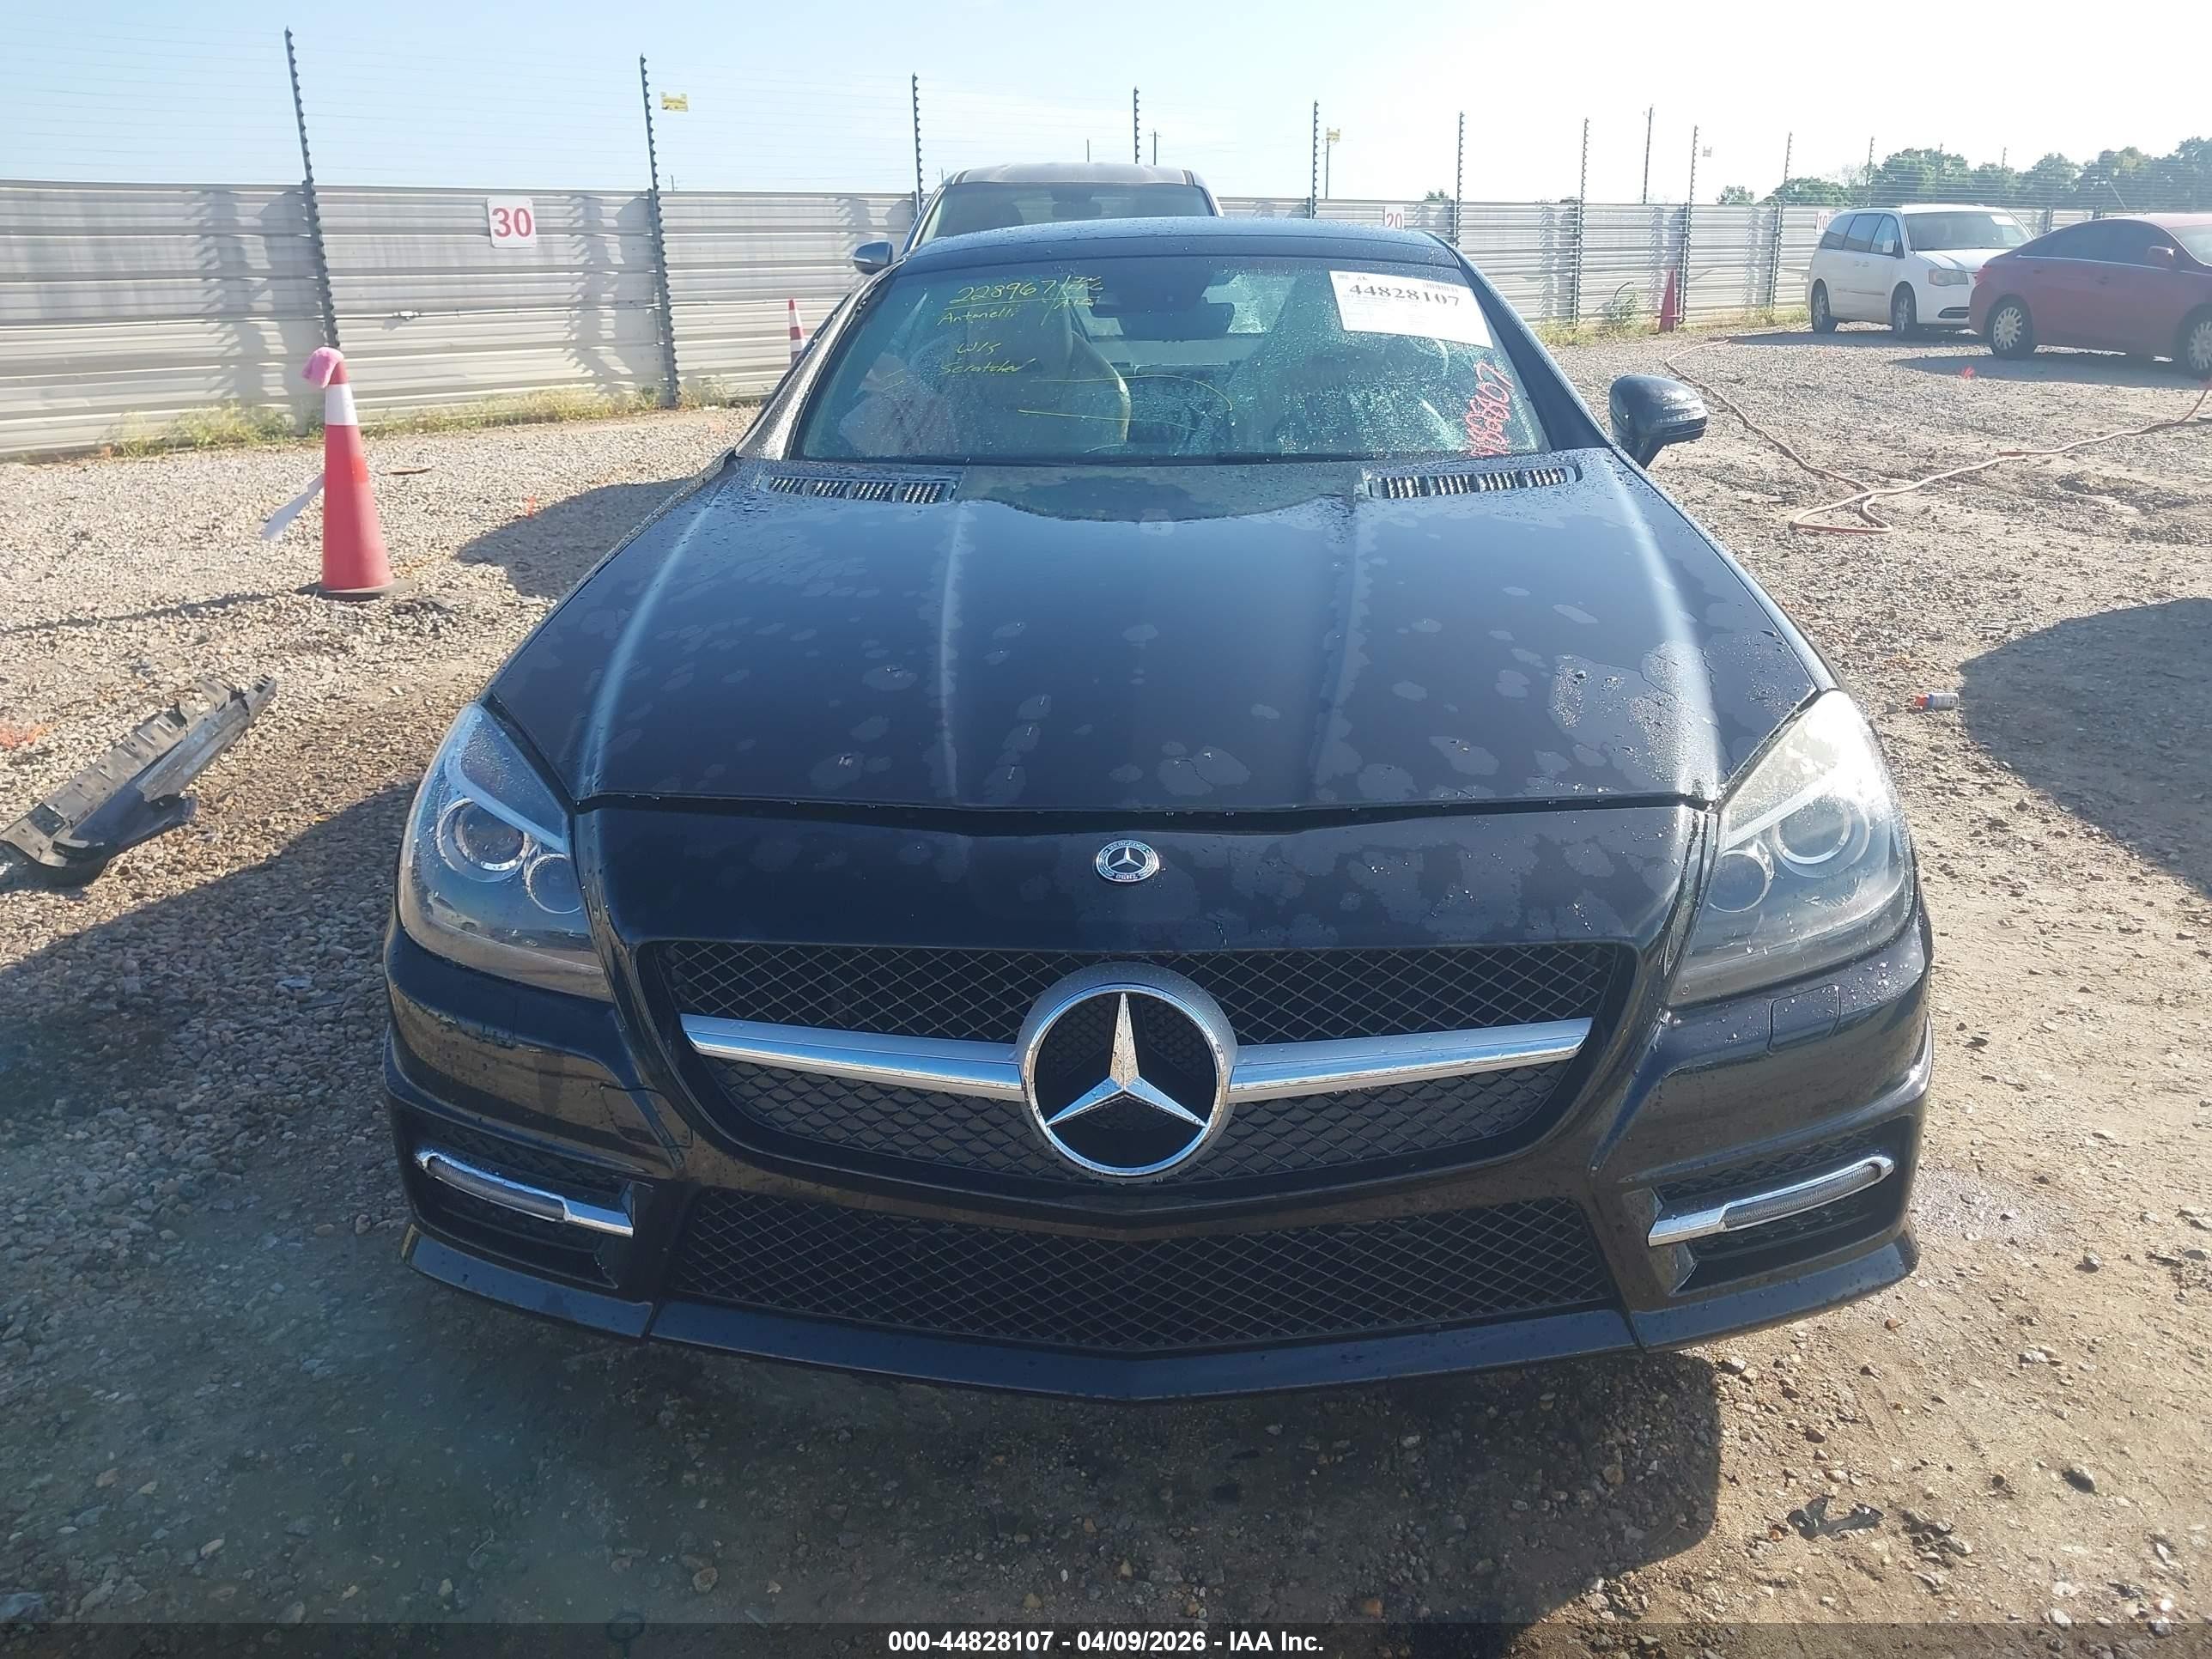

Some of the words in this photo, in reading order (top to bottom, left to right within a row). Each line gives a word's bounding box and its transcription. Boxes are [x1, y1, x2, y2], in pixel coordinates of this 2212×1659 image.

[492, 207, 532, 238] 30
[1386, 213, 1403, 230] 20
[1818, 215, 1828, 231] 10
[1349, 284, 1460, 307] 44828107
